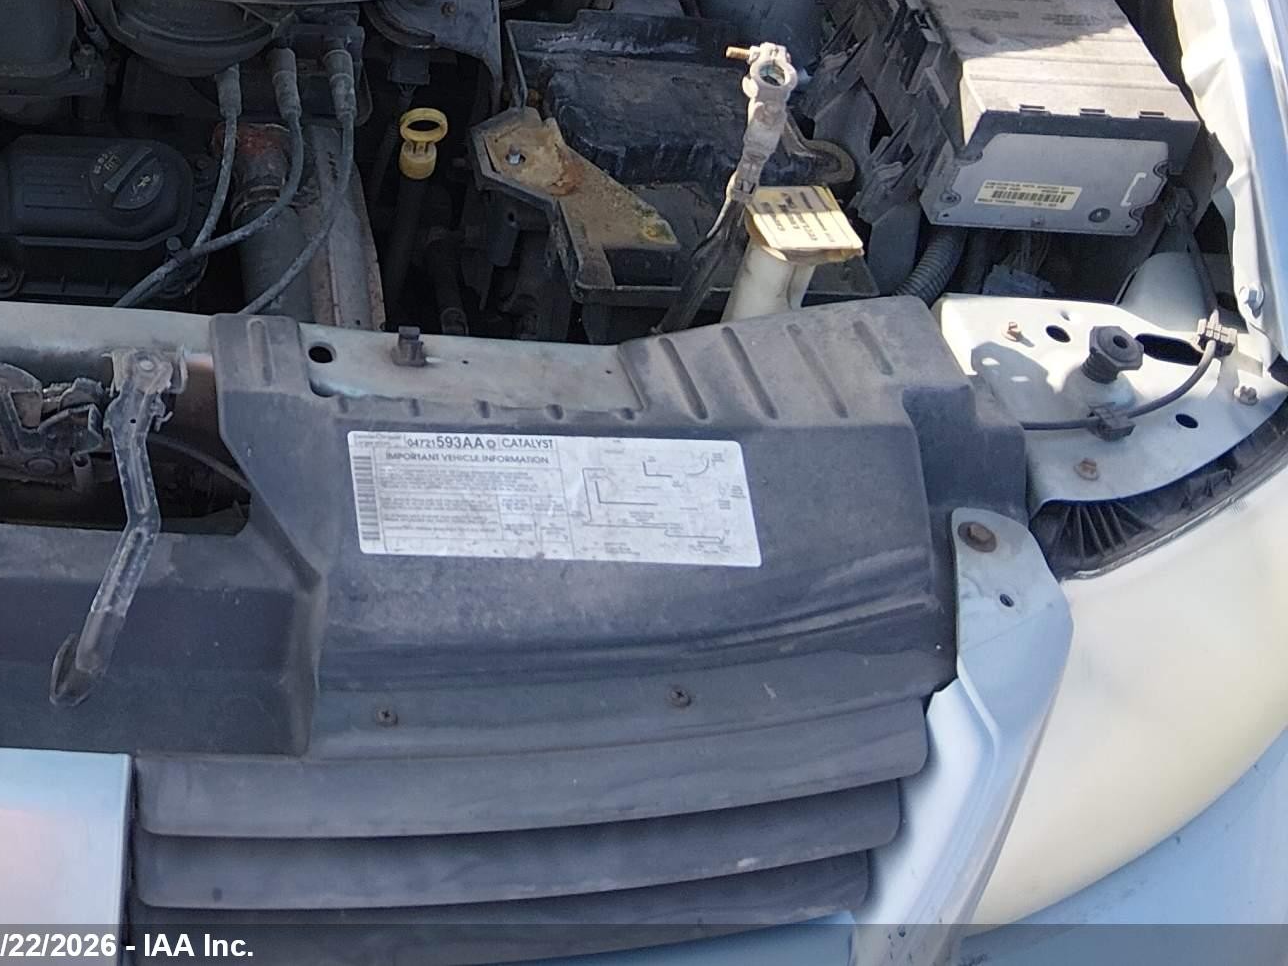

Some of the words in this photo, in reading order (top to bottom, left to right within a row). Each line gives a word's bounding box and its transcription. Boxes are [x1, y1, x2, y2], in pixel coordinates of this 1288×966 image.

[502, 438, 553, 449] CATALYST
[386, 452, 440, 461] IMPORTANT
[441, 453, 481, 463] VEHICLE
[482, 454, 549, 464] INFORMATION
